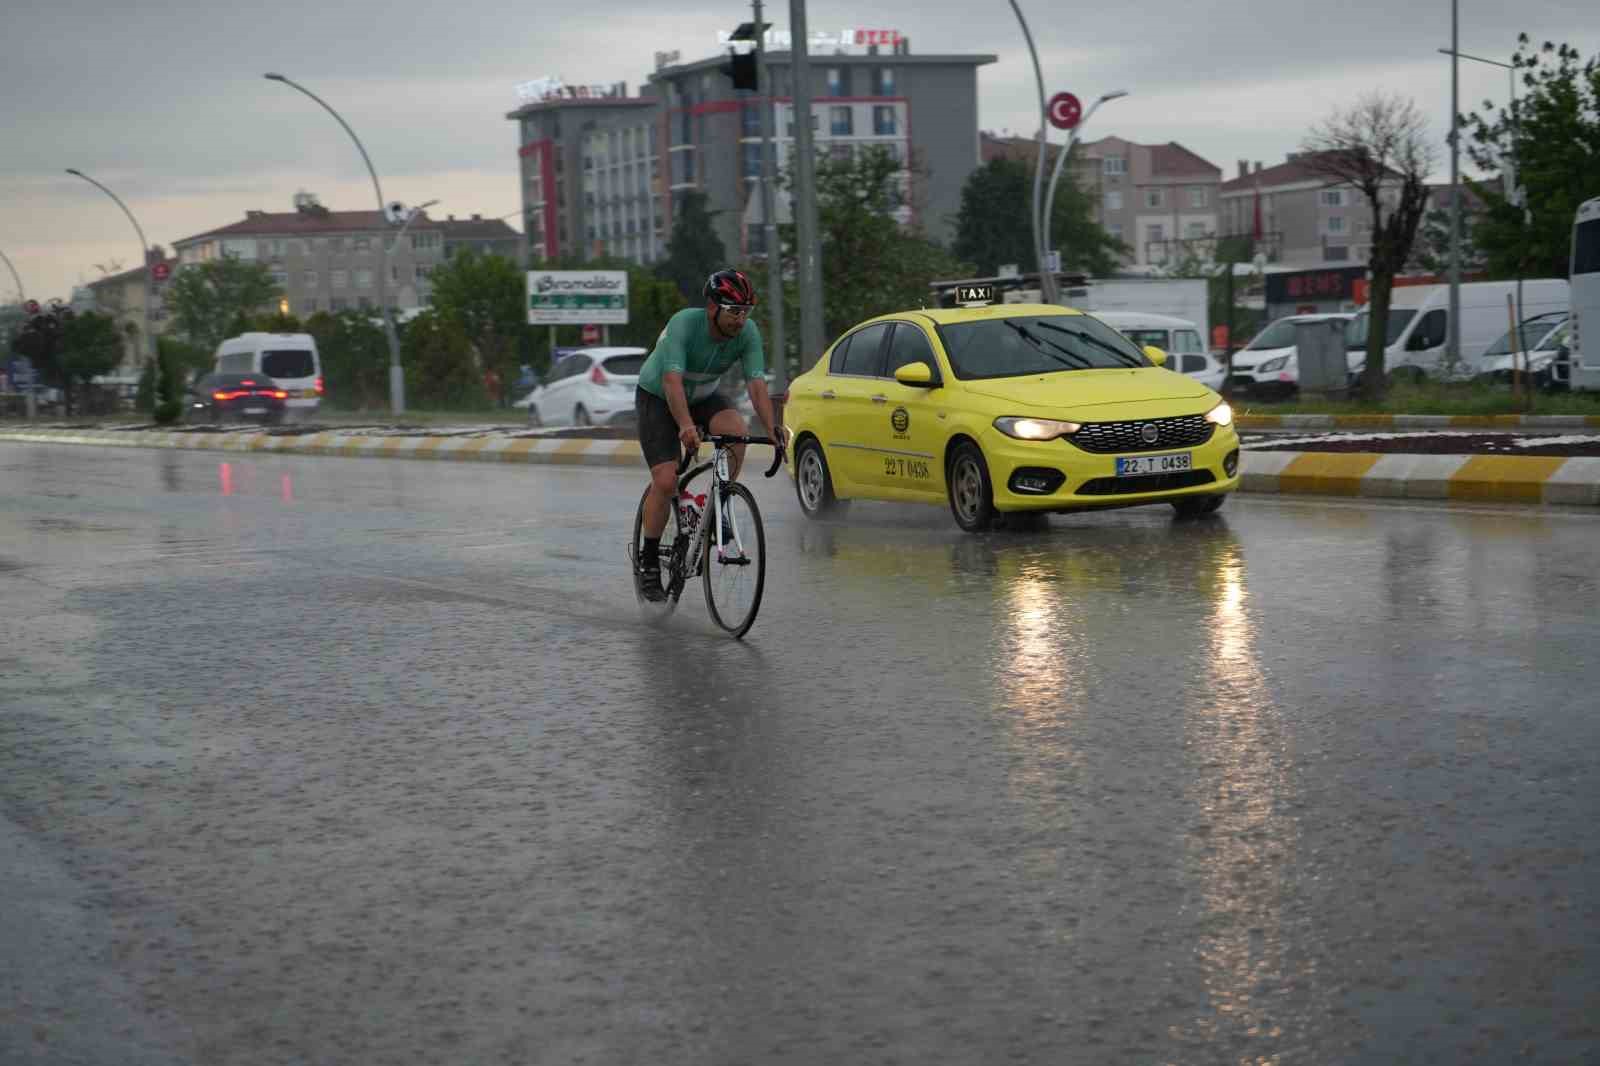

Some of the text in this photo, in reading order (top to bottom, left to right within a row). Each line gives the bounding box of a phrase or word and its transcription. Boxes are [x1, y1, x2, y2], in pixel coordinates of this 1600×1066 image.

[960, 287, 991, 299] TAXI
[884, 456, 896, 475] 22
[896, 458, 905, 477] T
[1124, 455, 1189, 473] 22 T 0438
